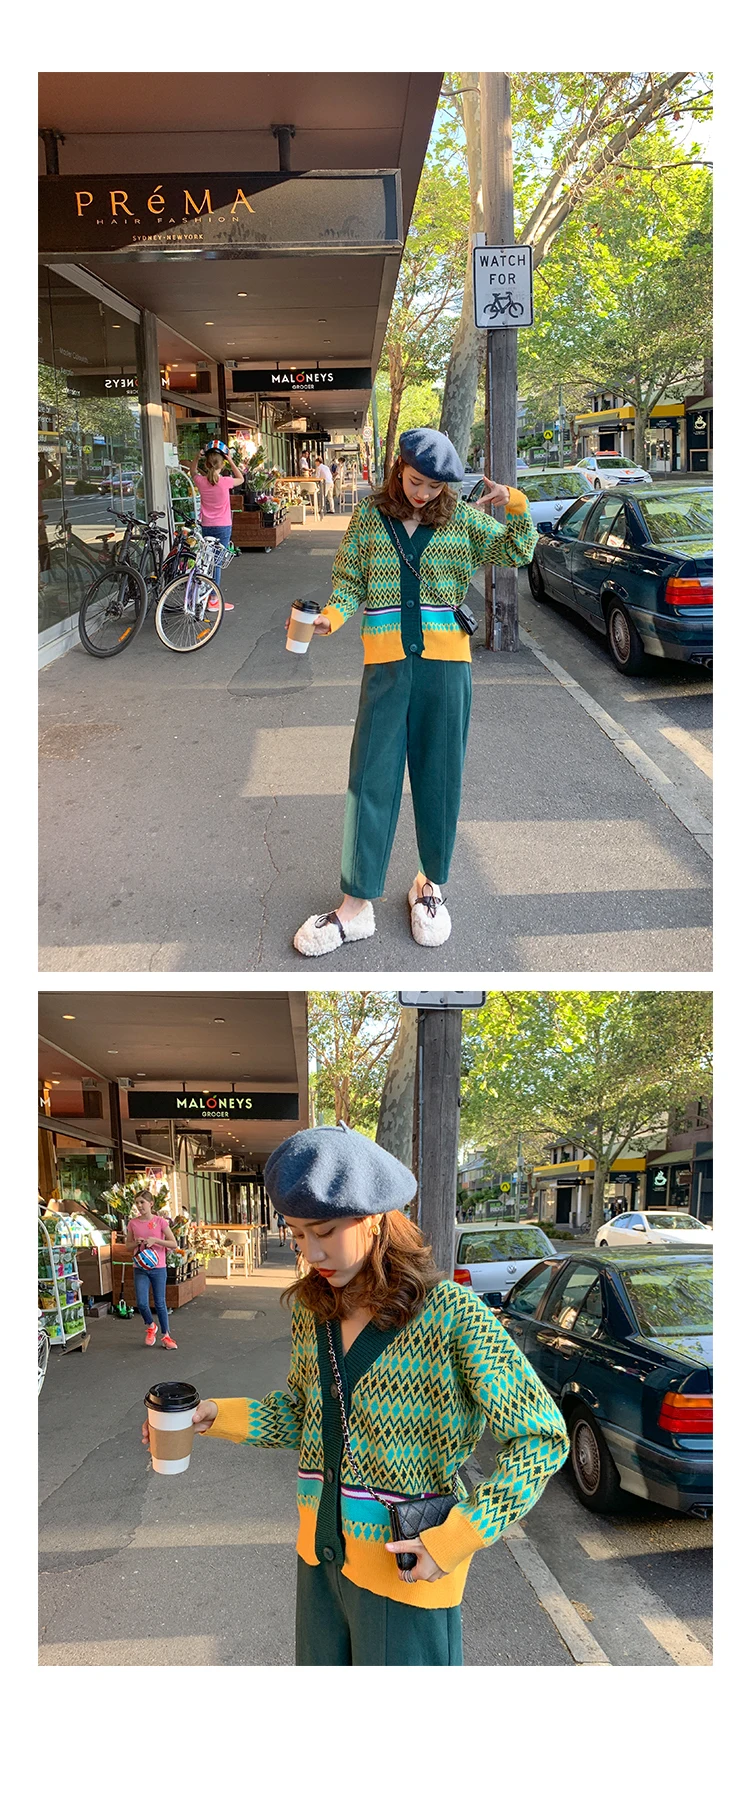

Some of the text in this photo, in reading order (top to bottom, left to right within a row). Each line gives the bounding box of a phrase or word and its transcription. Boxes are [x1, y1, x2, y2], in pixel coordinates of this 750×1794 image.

[75, 185, 256, 216] PRéMA
[157, 216, 240, 225] FASHION
[479, 255, 526, 267] WATCH
[489, 273, 516, 285] FOR
[271, 372, 334, 384] MALONEYS
[176, 1096, 253, 1110] MALONEYS
